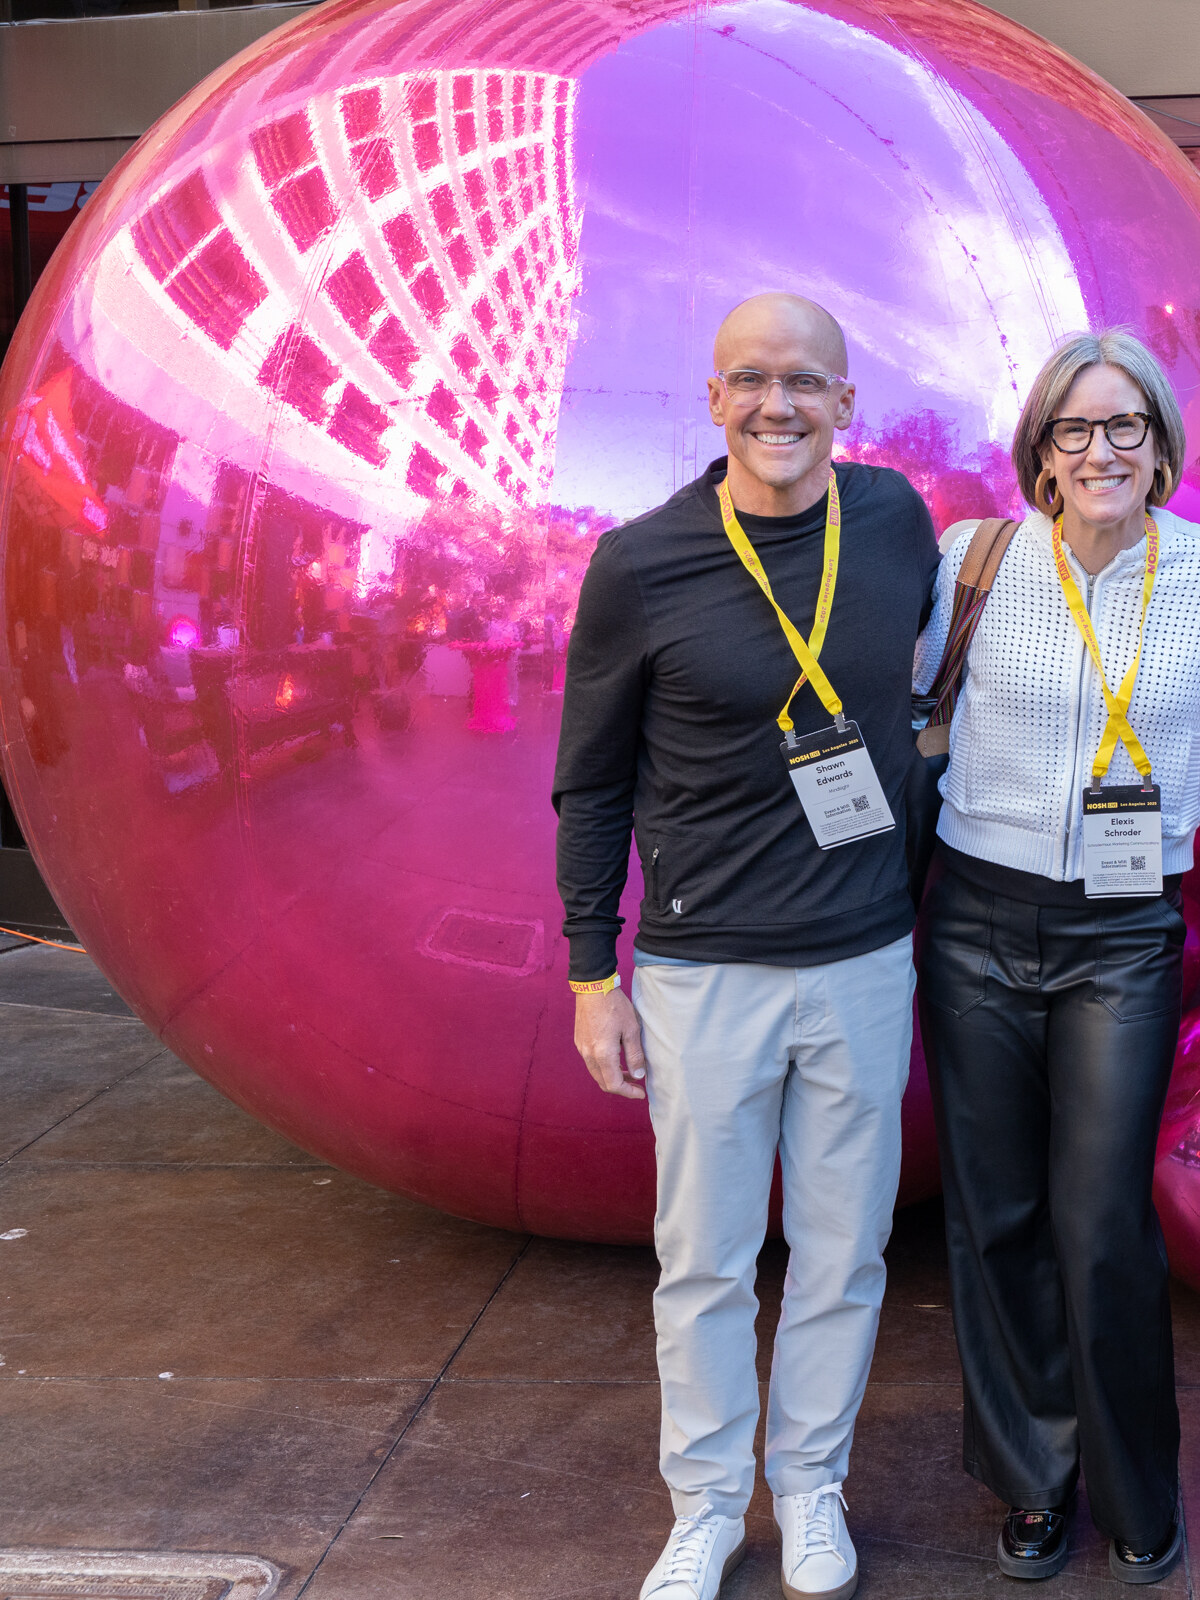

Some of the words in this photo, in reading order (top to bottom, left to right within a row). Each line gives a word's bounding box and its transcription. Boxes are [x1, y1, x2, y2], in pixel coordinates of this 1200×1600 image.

[721, 488, 733, 522] NOSH
[829, 505, 839, 526] LIVE
[1145, 517, 1158, 533] LIVE
[1052, 522, 1063, 564] NOSH
[1147, 534, 1158, 574] NOSH
[1057, 560, 1071, 582] LIVE
[823, 573, 833, 603] Angeles
[789, 753, 810, 765] NOSH
[816, 760, 846, 774] Shawn
[816, 769, 853, 786] Edwards
[1087, 802, 1107, 810] NOSH
[1111, 818, 1135, 826] Elexis
[1104, 829, 1142, 837] Schroder
[590, 982, 603, 992] LIV
